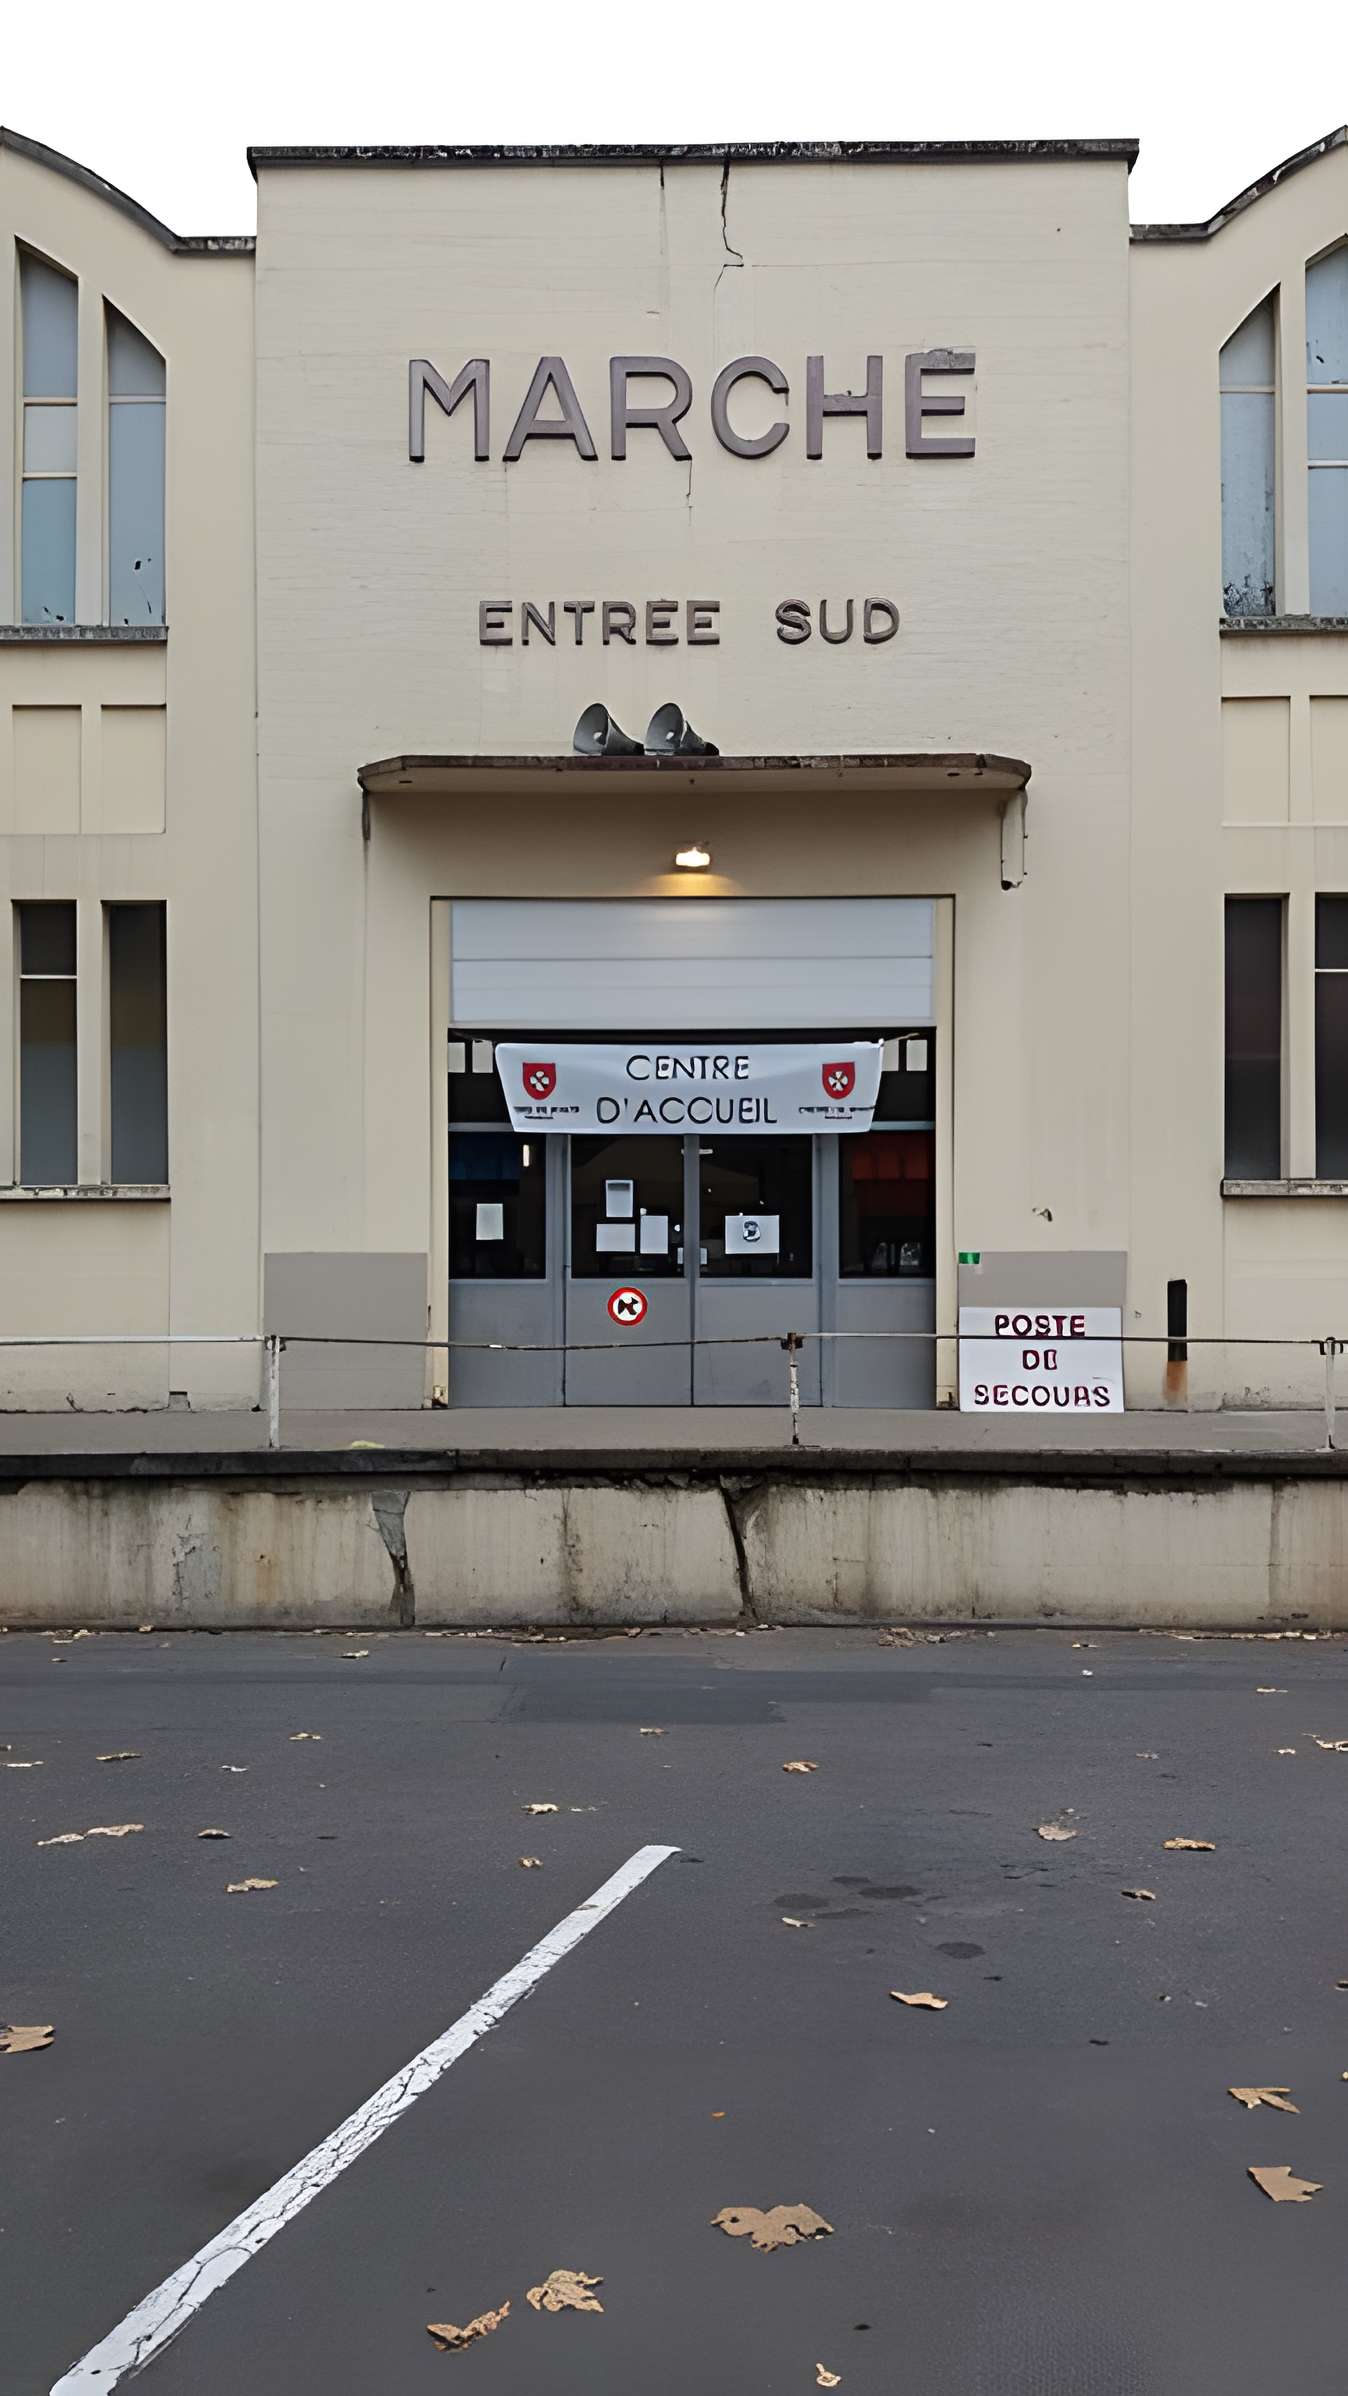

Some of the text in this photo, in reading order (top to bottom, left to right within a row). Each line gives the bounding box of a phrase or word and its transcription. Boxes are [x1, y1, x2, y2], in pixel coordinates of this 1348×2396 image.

[408, 351, 976, 462] MARCHE
[479, 598, 900, 645] ENTREE SUD
[625, 1054, 750, 1081] CENTRE
[596, 1096, 778, 1125] D'ACCUEIL
[994, 1314, 1086, 1337] POSTE
